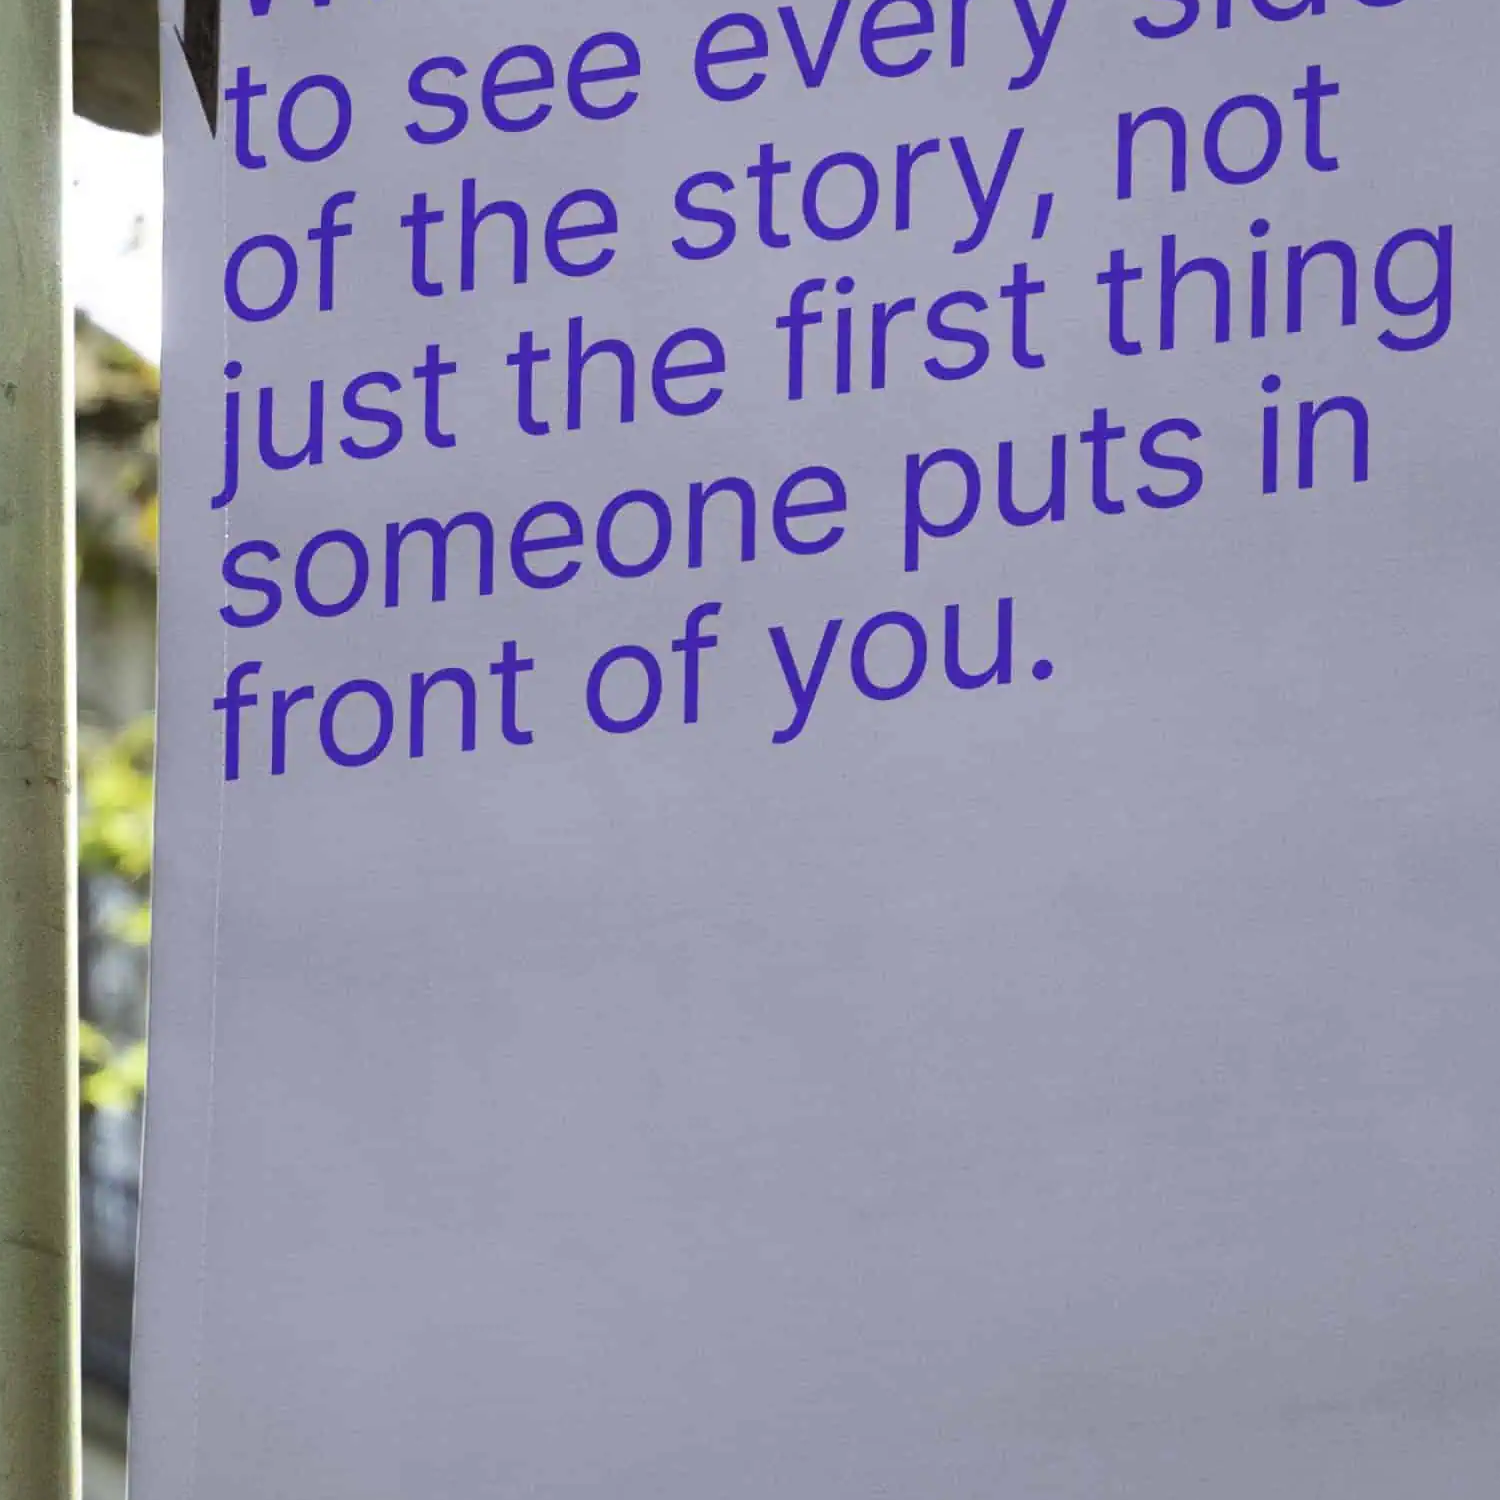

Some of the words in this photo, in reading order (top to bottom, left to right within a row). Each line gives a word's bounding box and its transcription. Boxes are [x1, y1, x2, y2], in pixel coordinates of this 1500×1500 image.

[223, 191, 357, 322] of
[399, 178, 618, 297] the
[671, 127, 1054, 261] story,
[1116, 65, 1340, 200] not
[224, 64, 353, 170] to
[406, 31, 641, 145] see
[210, 341, 458, 510] just
[506, 315, 726, 437] the
[775, 263, 1046, 401] first
[1095, 219, 1453, 357] thing
[219, 466, 847, 629] someone
[903, 407, 1204, 573] puts
[1261, 377, 1370, 496] in
[213, 640, 534, 781] front
[586, 601, 721, 734] of
[768, 596, 1055, 745] you.
